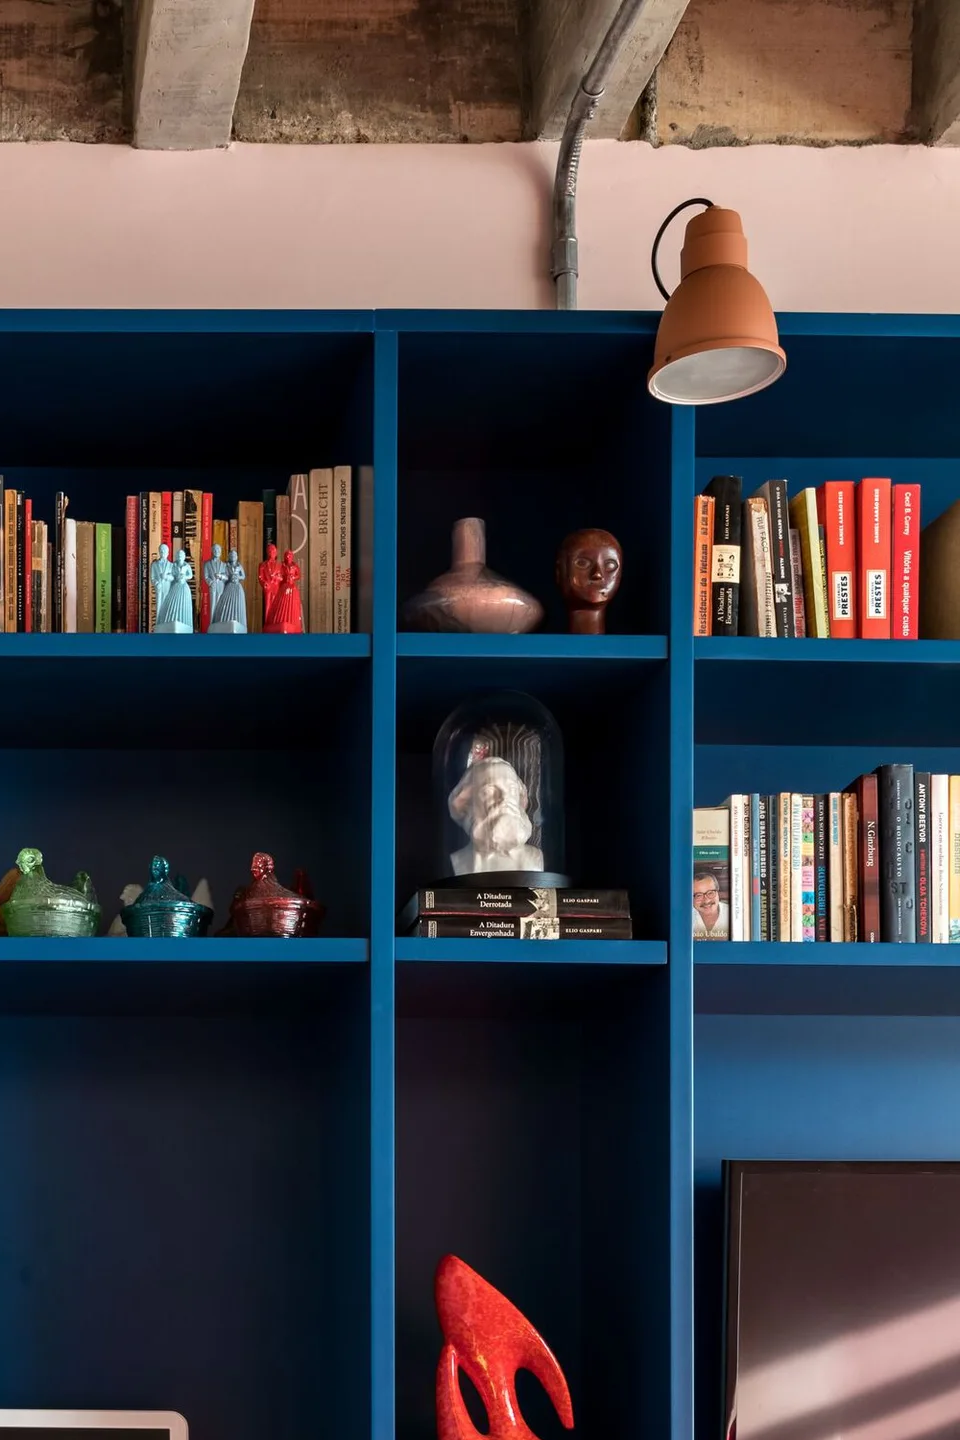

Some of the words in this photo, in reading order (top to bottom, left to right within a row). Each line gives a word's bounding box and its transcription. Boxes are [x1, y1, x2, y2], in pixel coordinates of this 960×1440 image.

[318, 483, 329, 534] BRECHT
[756, 517, 765, 530] RUI
[903, 550, 913, 574] Vitória
[100, 599, 107, 608] da
[717, 587, 725, 614] Ditadura
[725, 587, 733, 625] Escancarada
[841, 575, 849, 615] PRESTES
[900, 582, 911, 614] qualquer
[698, 590, 708, 634] Resistência
[902, 615, 911, 636] custo
[918, 783, 926, 813] ANTONY
[918, 814, 927, 843] BEEVOR
[476, 892, 483, 900] A
[484, 892, 513, 900] Ditadura
[479, 900, 513, 908] Derrotada
[818, 866, 826, 916] LIBERDADE
[469, 929, 515, 938] Envergonhada
